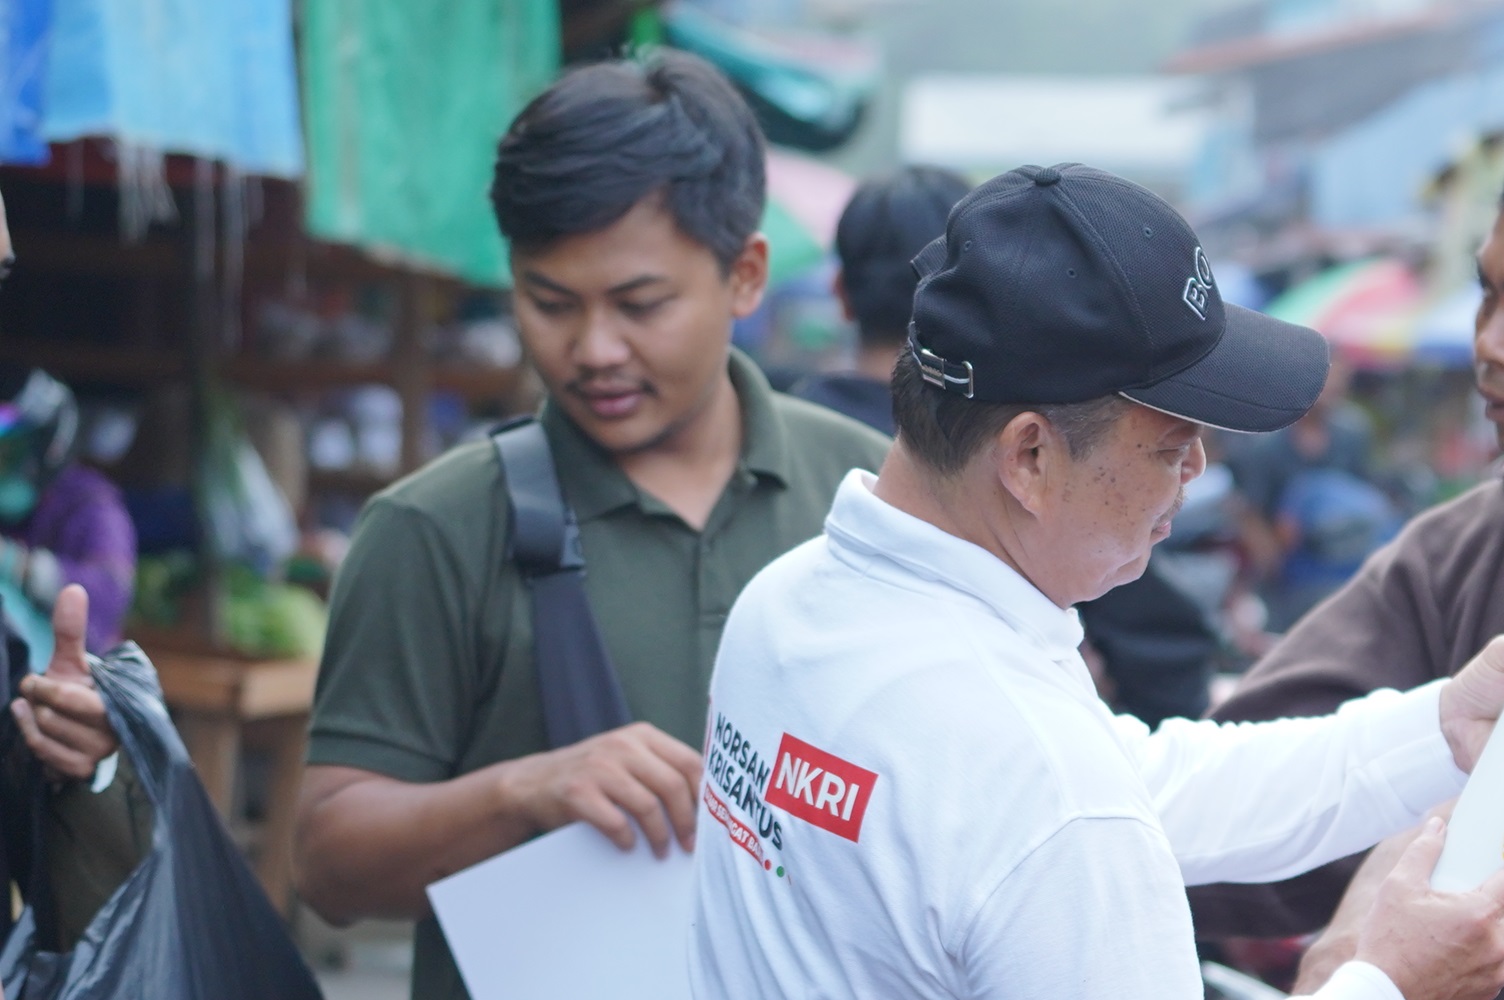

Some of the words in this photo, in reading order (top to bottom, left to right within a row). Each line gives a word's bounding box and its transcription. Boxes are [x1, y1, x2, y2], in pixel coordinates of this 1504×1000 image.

[714, 712, 771, 793] NORSAN
[775, 751, 860, 822] NKRI
[708, 744, 784, 851] KRISANTUS
